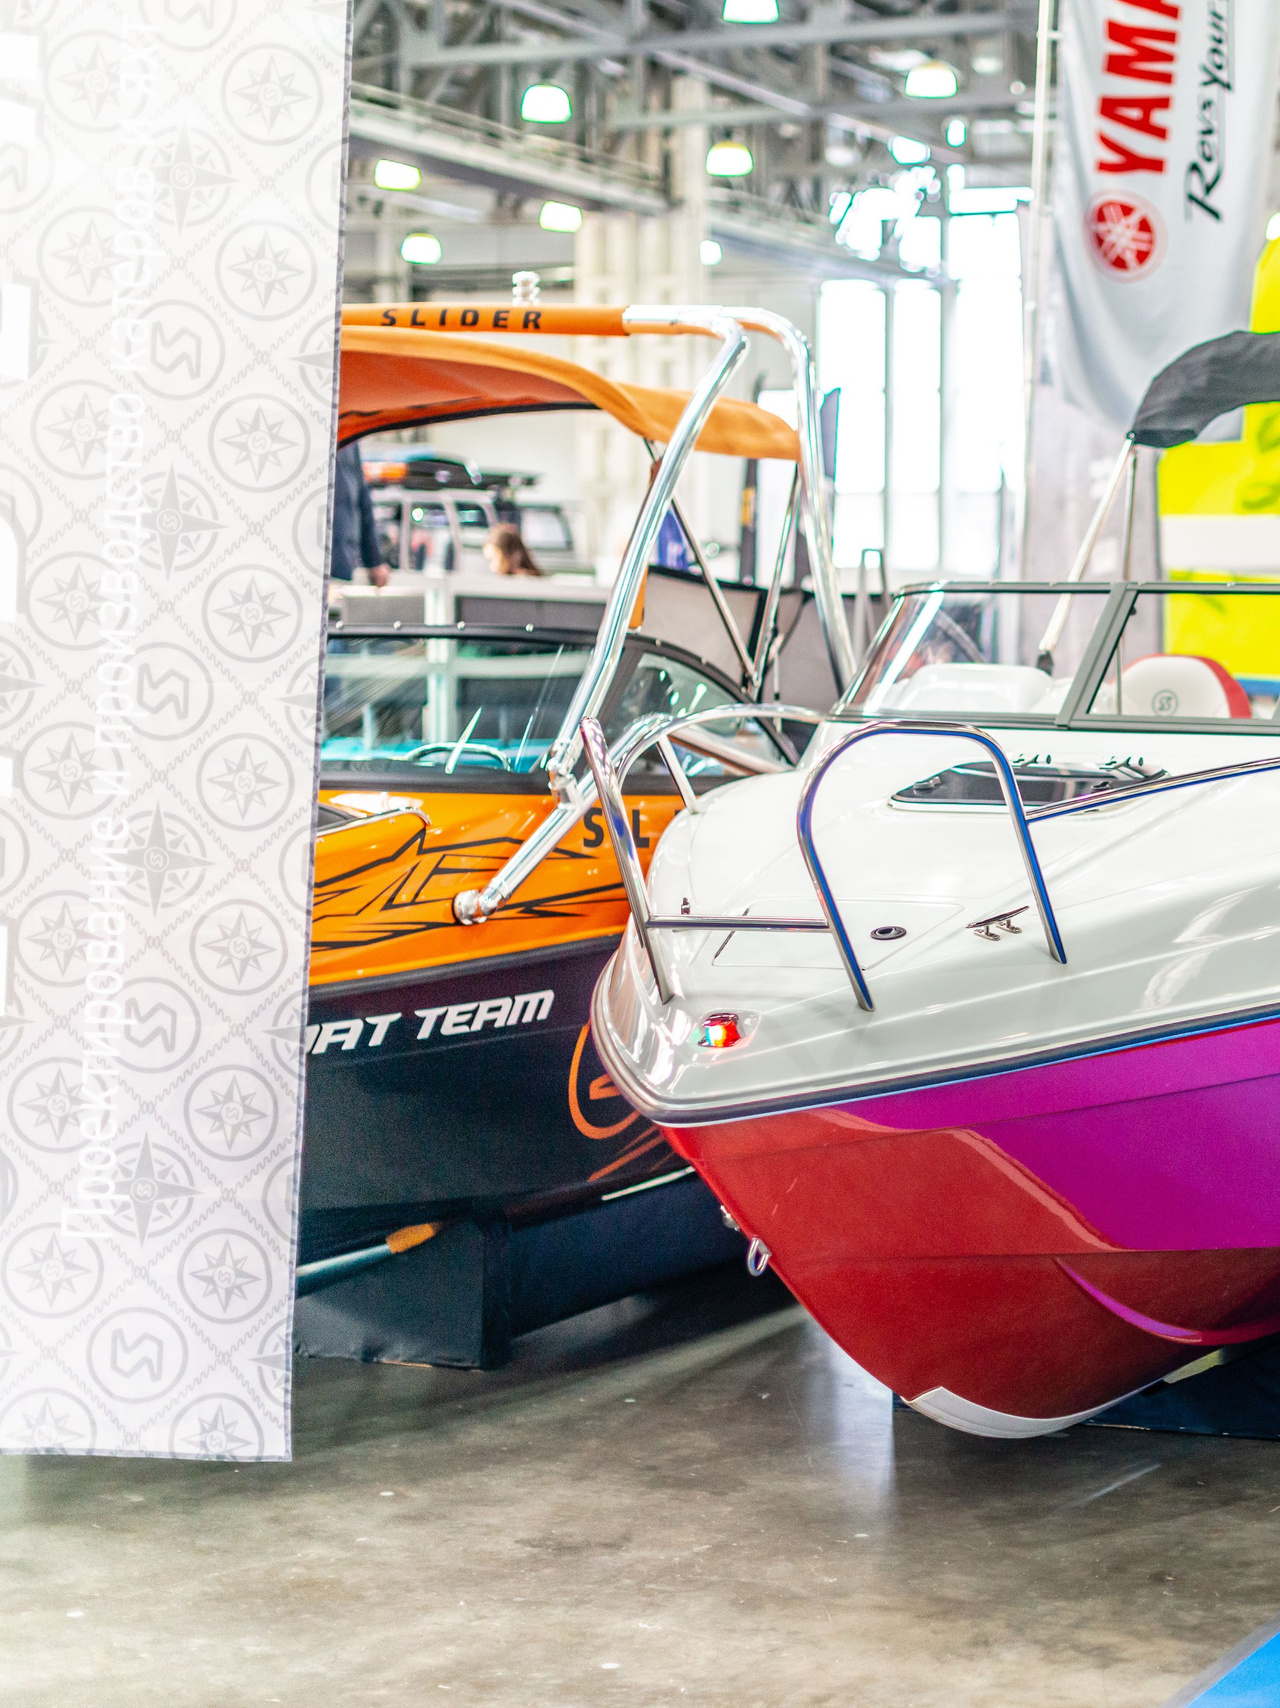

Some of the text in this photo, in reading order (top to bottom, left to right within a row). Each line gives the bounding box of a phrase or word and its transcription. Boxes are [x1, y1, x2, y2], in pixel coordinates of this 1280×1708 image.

[1185, 98, 1223, 221] Revs
[381, 308, 543, 330] SLIDER
[60, 12, 166, 1239] Проектирование и производство катеров и яхт
[415, 989, 555, 1040] TEAM
